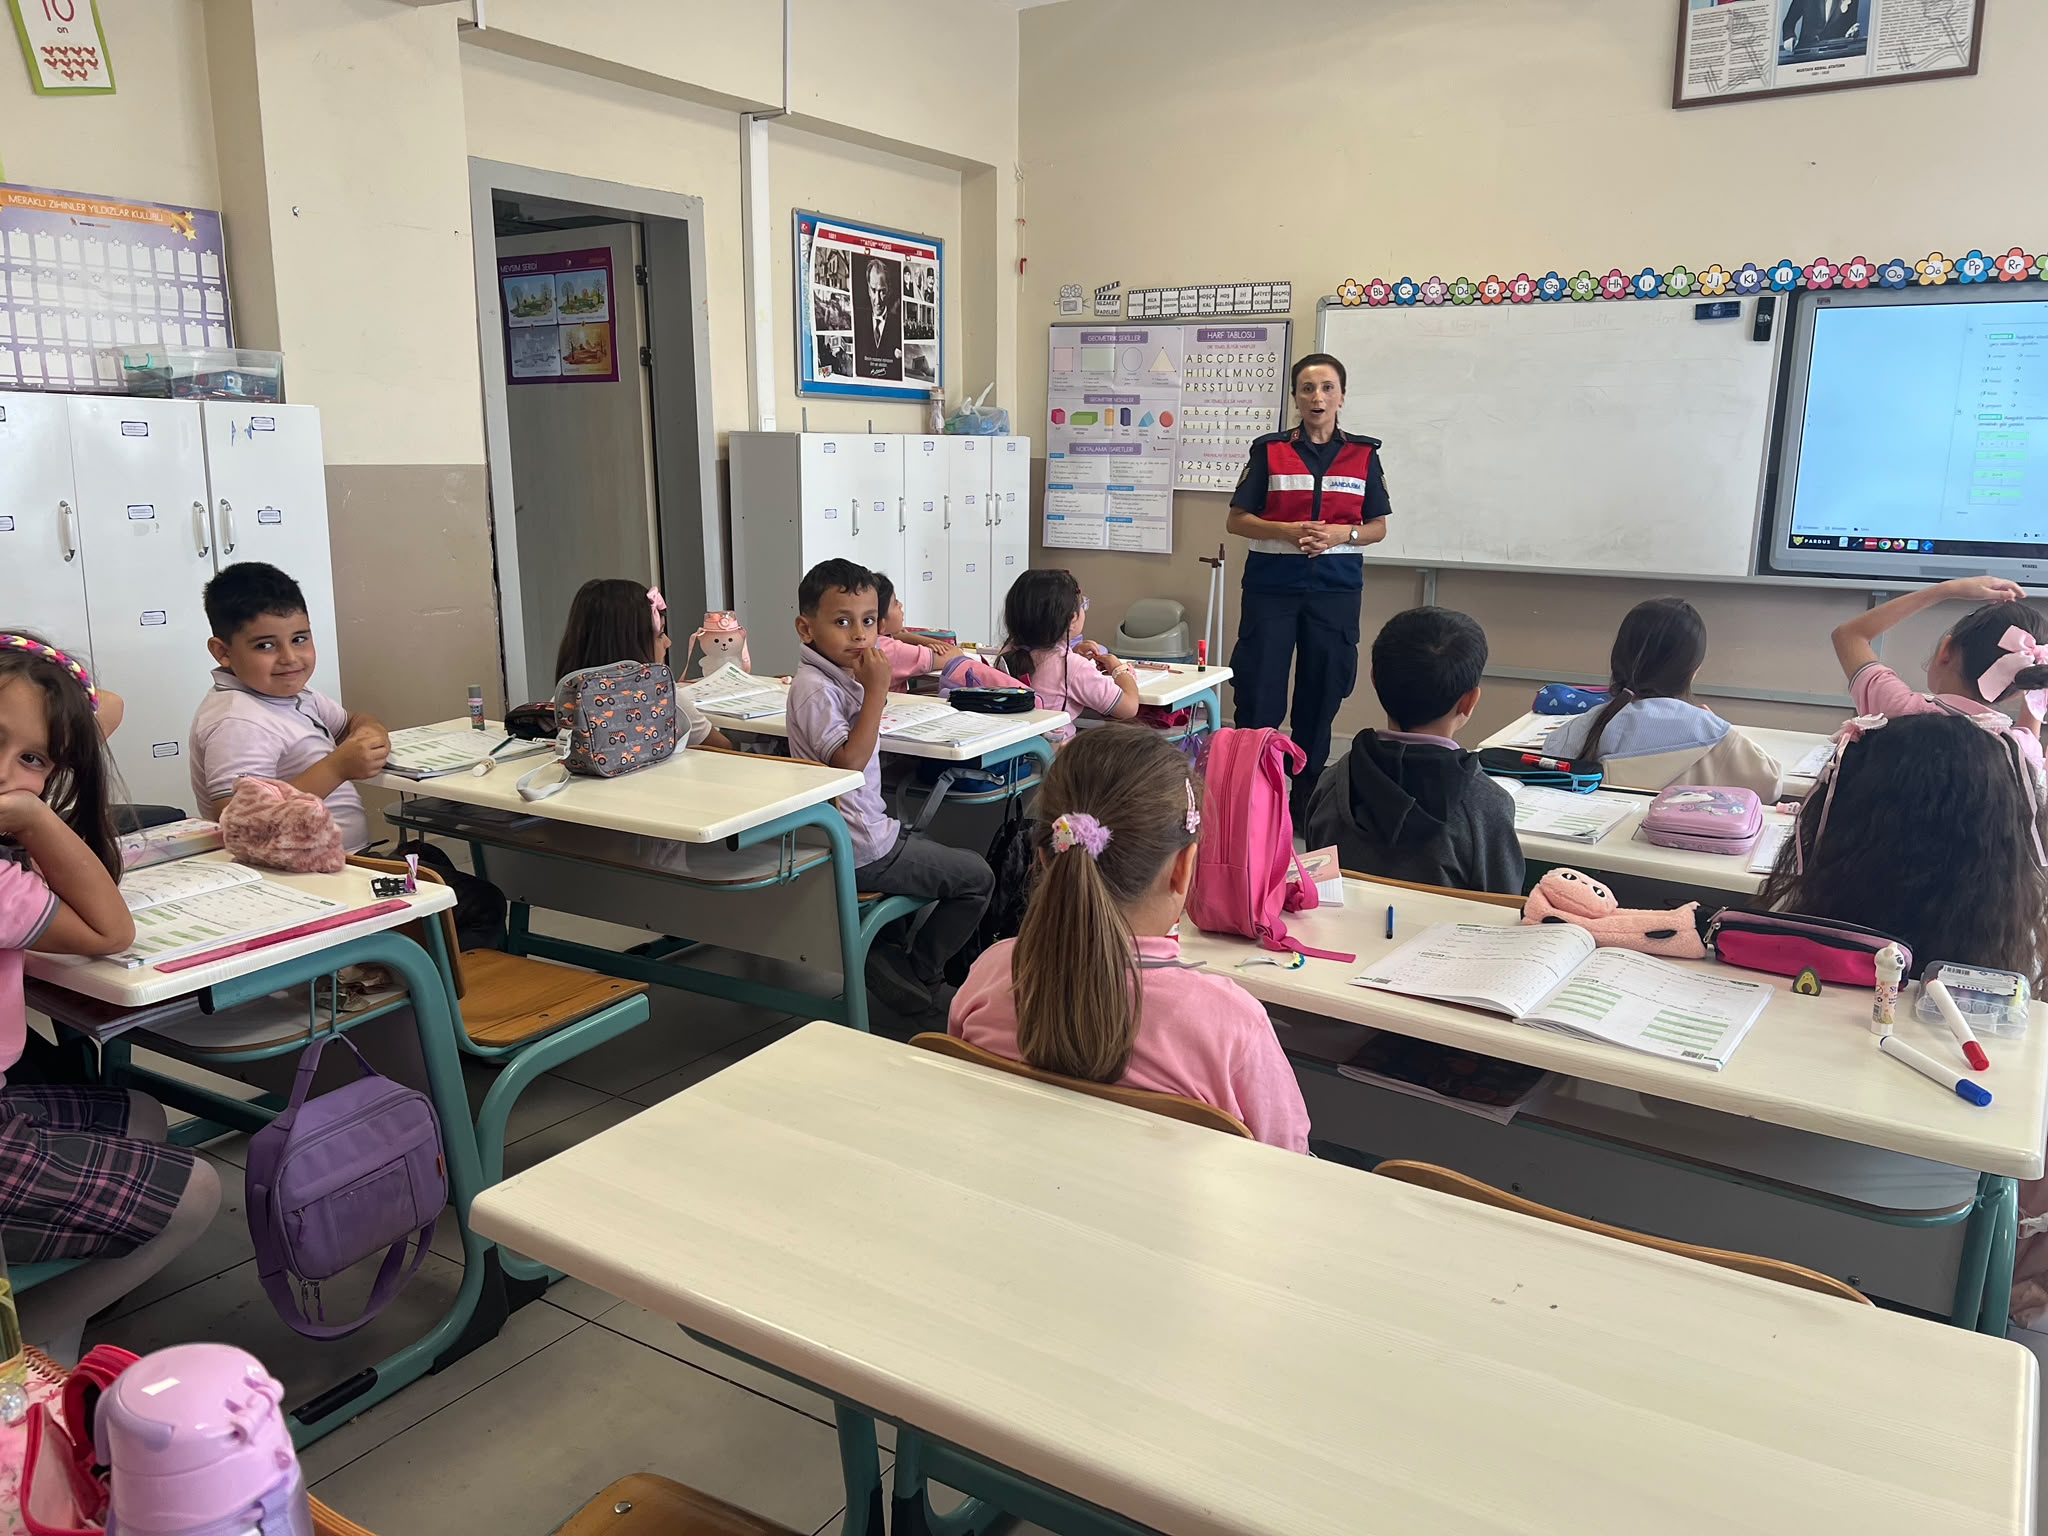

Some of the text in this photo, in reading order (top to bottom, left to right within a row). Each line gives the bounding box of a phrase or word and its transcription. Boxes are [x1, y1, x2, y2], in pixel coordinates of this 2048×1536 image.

[8, 194, 46, 208] MERAKLI
[1968, 260, 1980, 274] Pp
[2008, 260, 2022, 270] Rr
[1744, 274, 1756, 284] Kk
[1780, 271, 1789, 282] Ll
[1849, 269, 1864, 279] Nn
[1886, 270, 1902, 279] Oo
[1544, 281, 1558, 291] Gg
[1608, 279, 1622, 289] Hh
[1706, 274, 1719, 288] Jj
[1373, 288, 1383, 296] Bb
[1457, 287, 1469, 295] Dd
[1487, 286, 1497, 295] Ee
[1517, 284, 1527, 294] Ff
[1207, 331, 1256, 339] HARF TABLOSU
